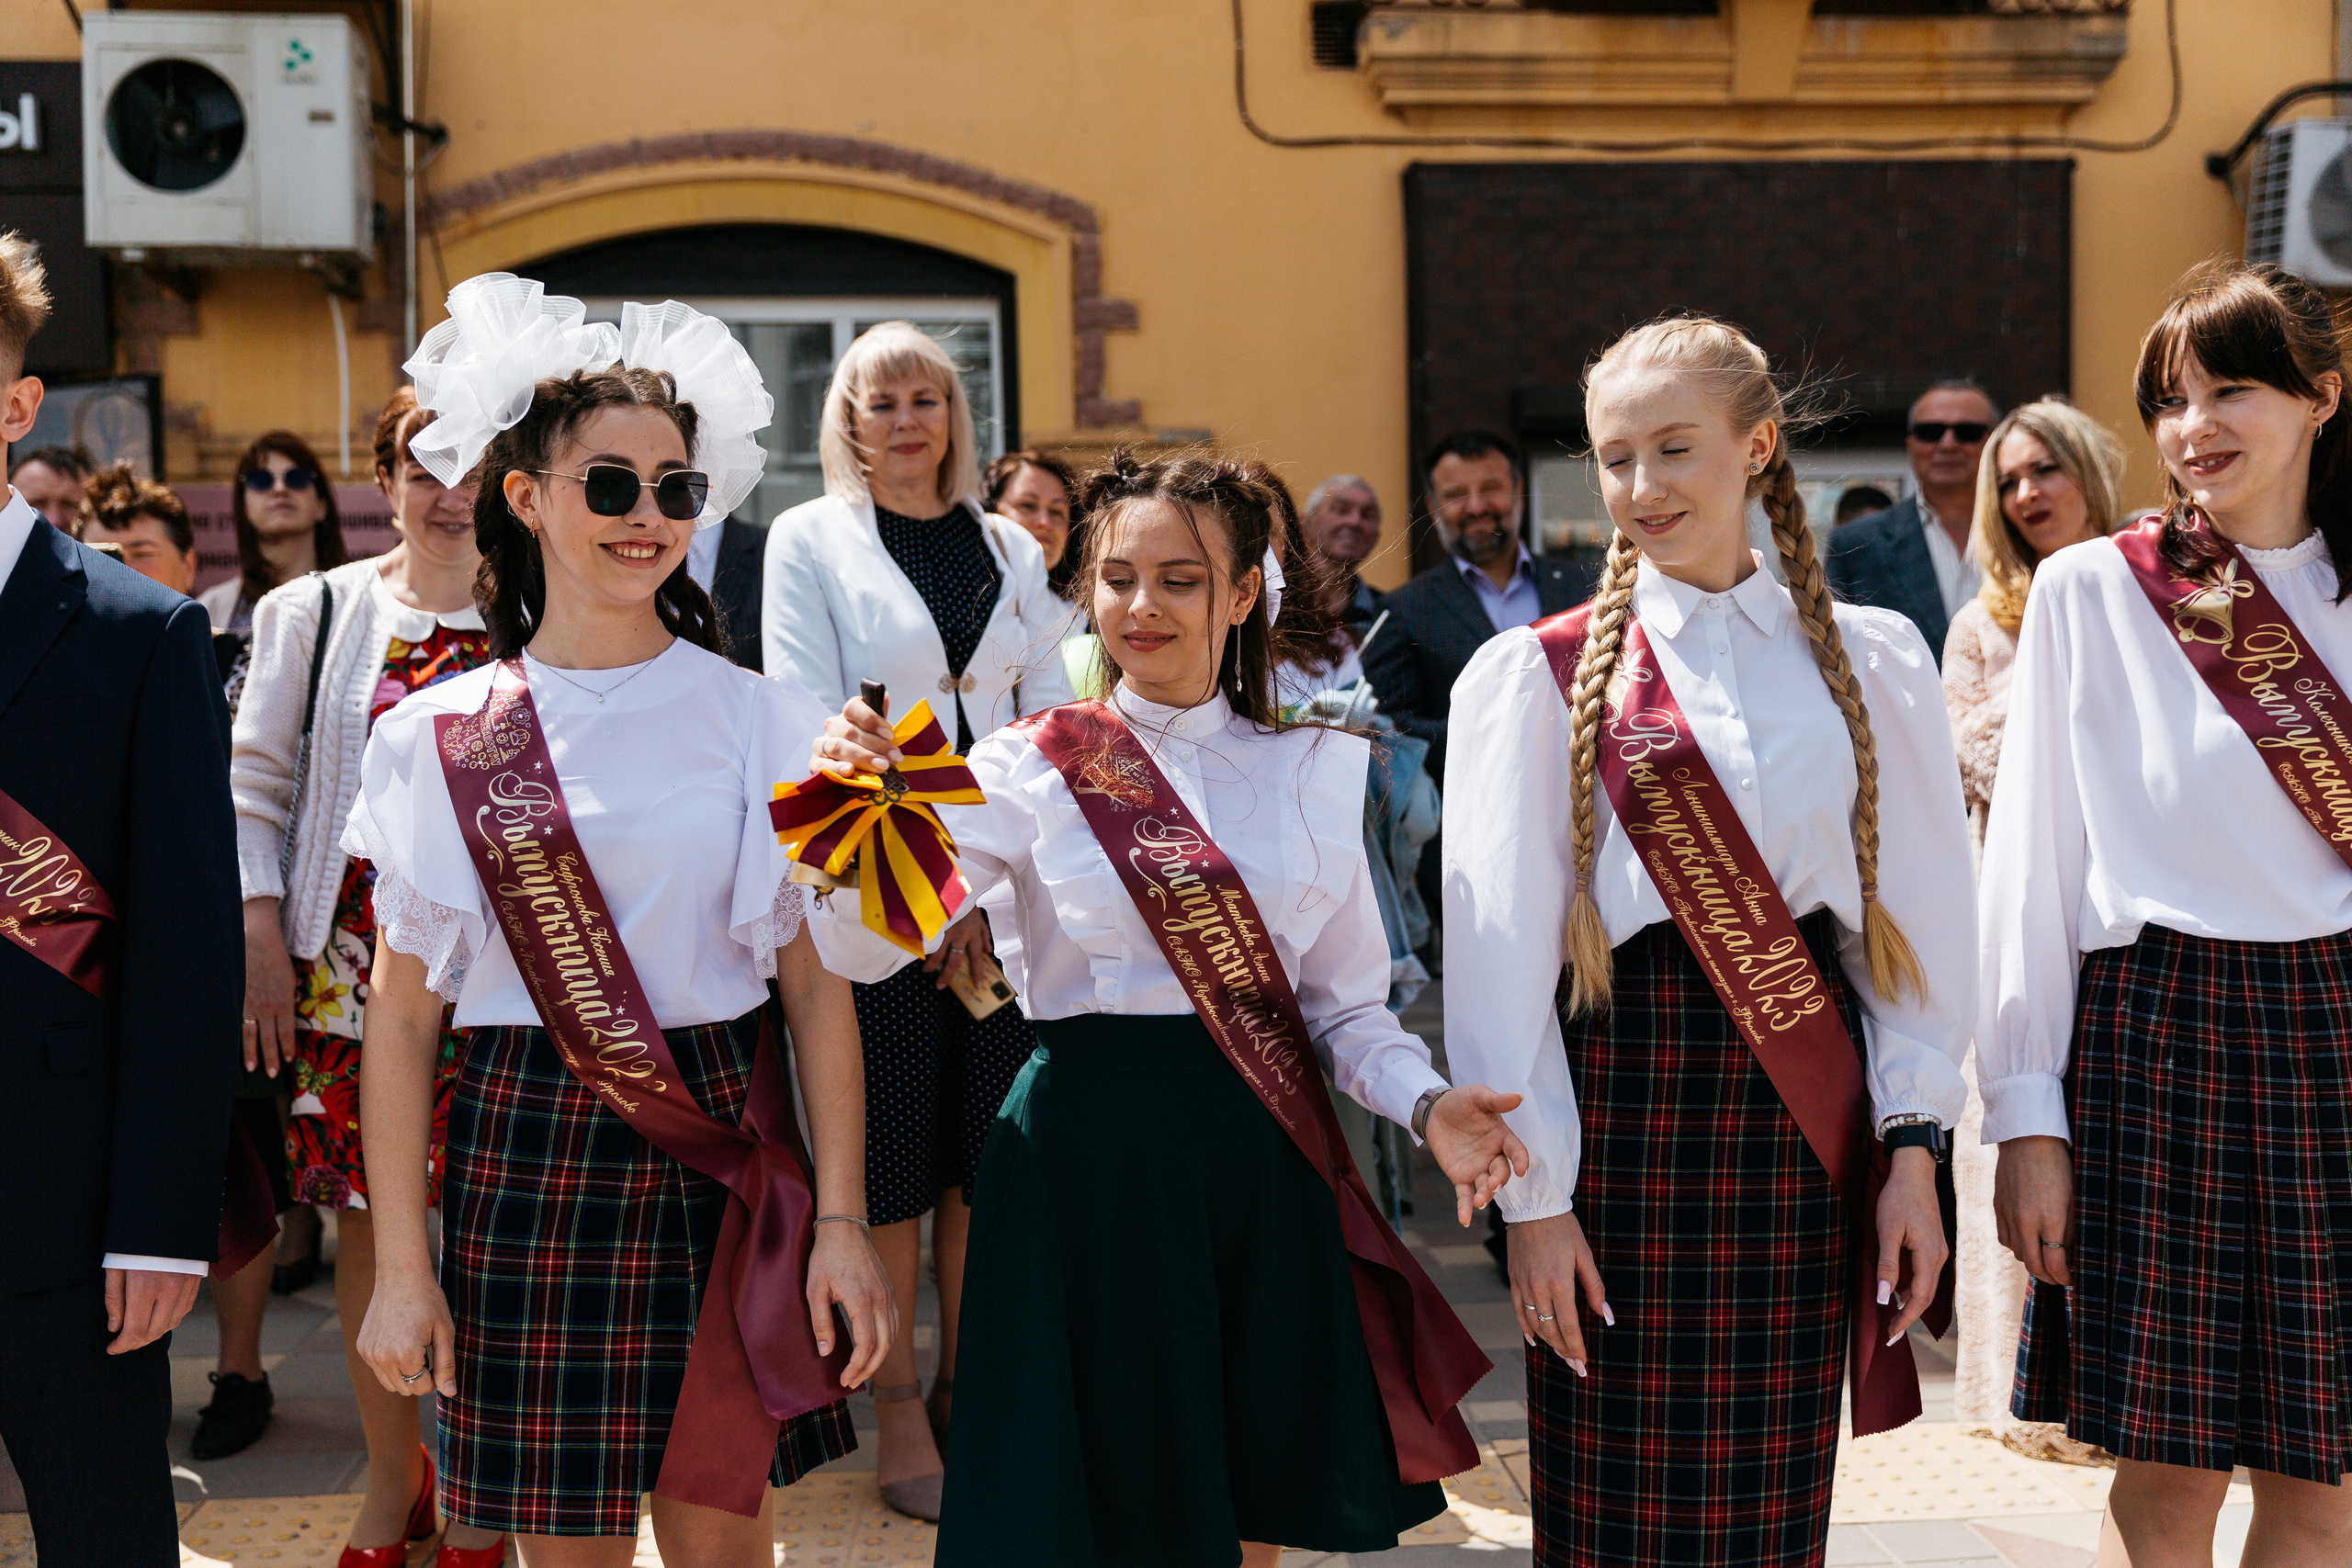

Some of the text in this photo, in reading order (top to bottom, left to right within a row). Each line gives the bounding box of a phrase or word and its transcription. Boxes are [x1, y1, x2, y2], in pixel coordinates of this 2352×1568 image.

[2222, 623, 2352, 851] Выпускниц
[489, 770, 613, 1025] Выпускница
[554, 852, 615, 978] Сафронова Ксения
[1134, 815, 1268, 1033] Выпускница
[1216, 884, 1271, 984] Матвеева Анна
[1610, 707, 1825, 1032] Выпускница 2023
[1735, 876, 1770, 926] Анна
[518, 947, 557, 1025] «Православная
[1672, 896, 1711, 959] «Православная
[1708, 959, 1735, 998] гимназия»
[1733, 1005, 1765, 1045] Фролово
[1192, 978, 1232, 1047] «Православная
[1230, 1046, 1264, 1089] гимназия»
[1269, 1093, 1295, 1131] Фролово
